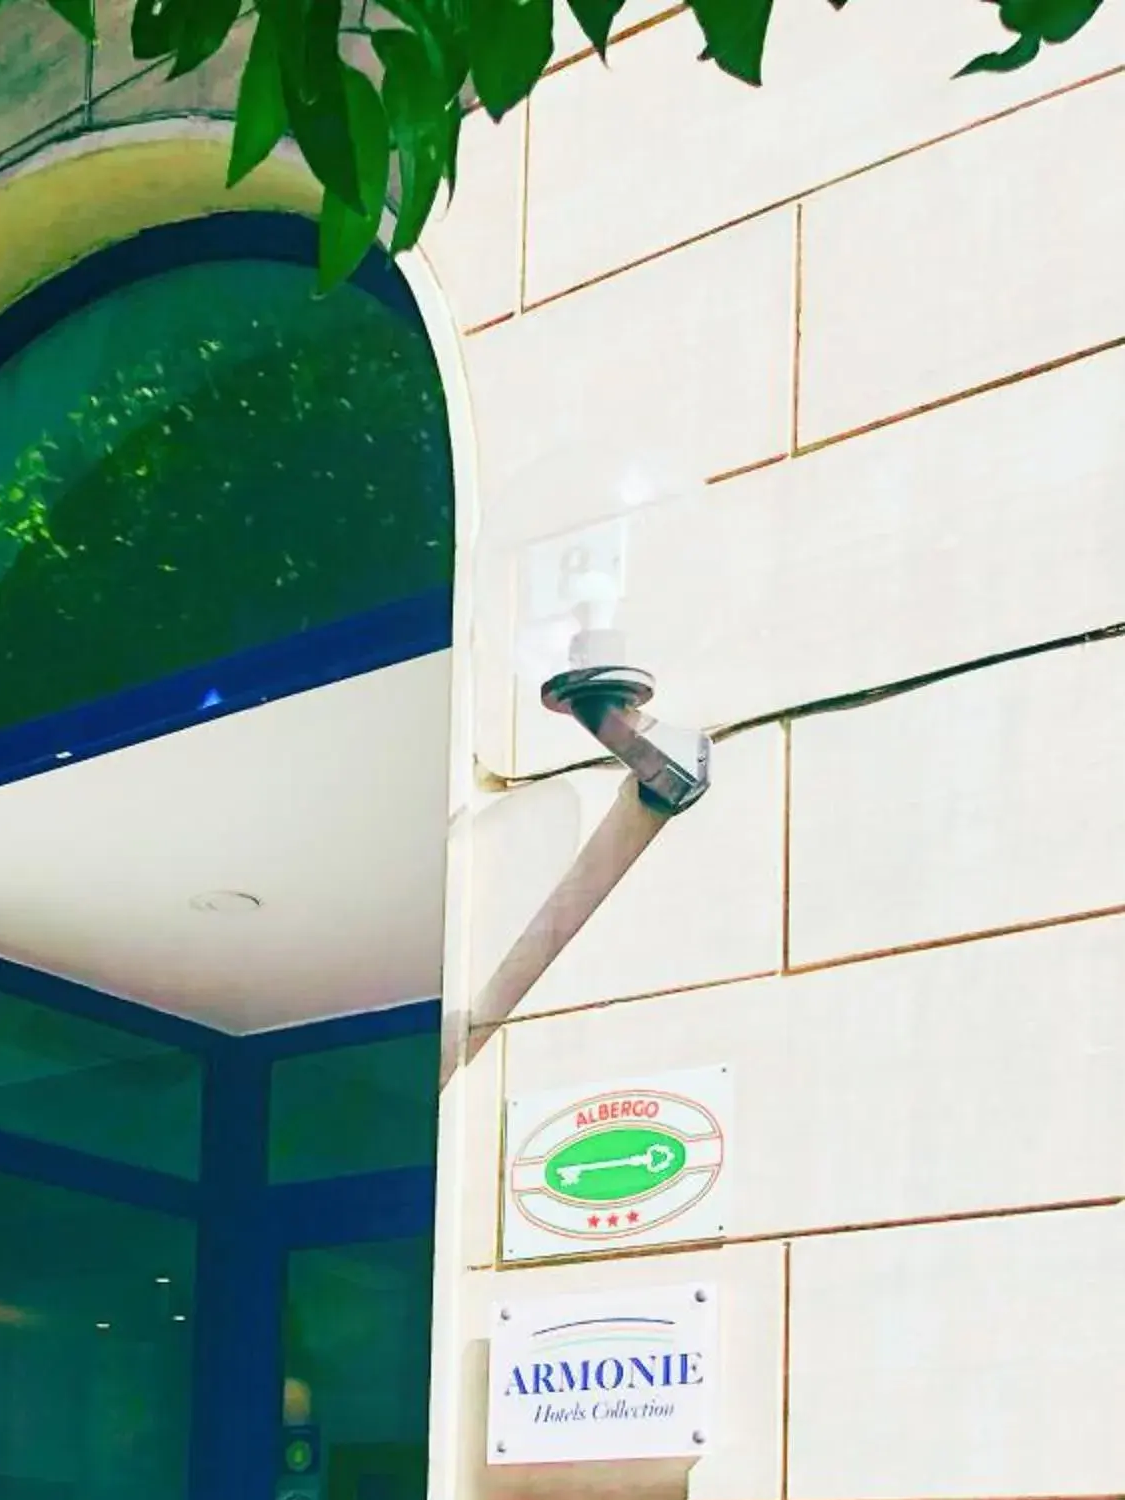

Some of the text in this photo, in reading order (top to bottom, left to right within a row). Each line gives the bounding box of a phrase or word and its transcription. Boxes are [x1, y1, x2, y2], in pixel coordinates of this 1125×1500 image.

[576, 1100, 661, 1129] ALBERGO
[504, 1352, 704, 1396] ARMONIE
[534, 1398, 674, 1424] Hotels Collection
